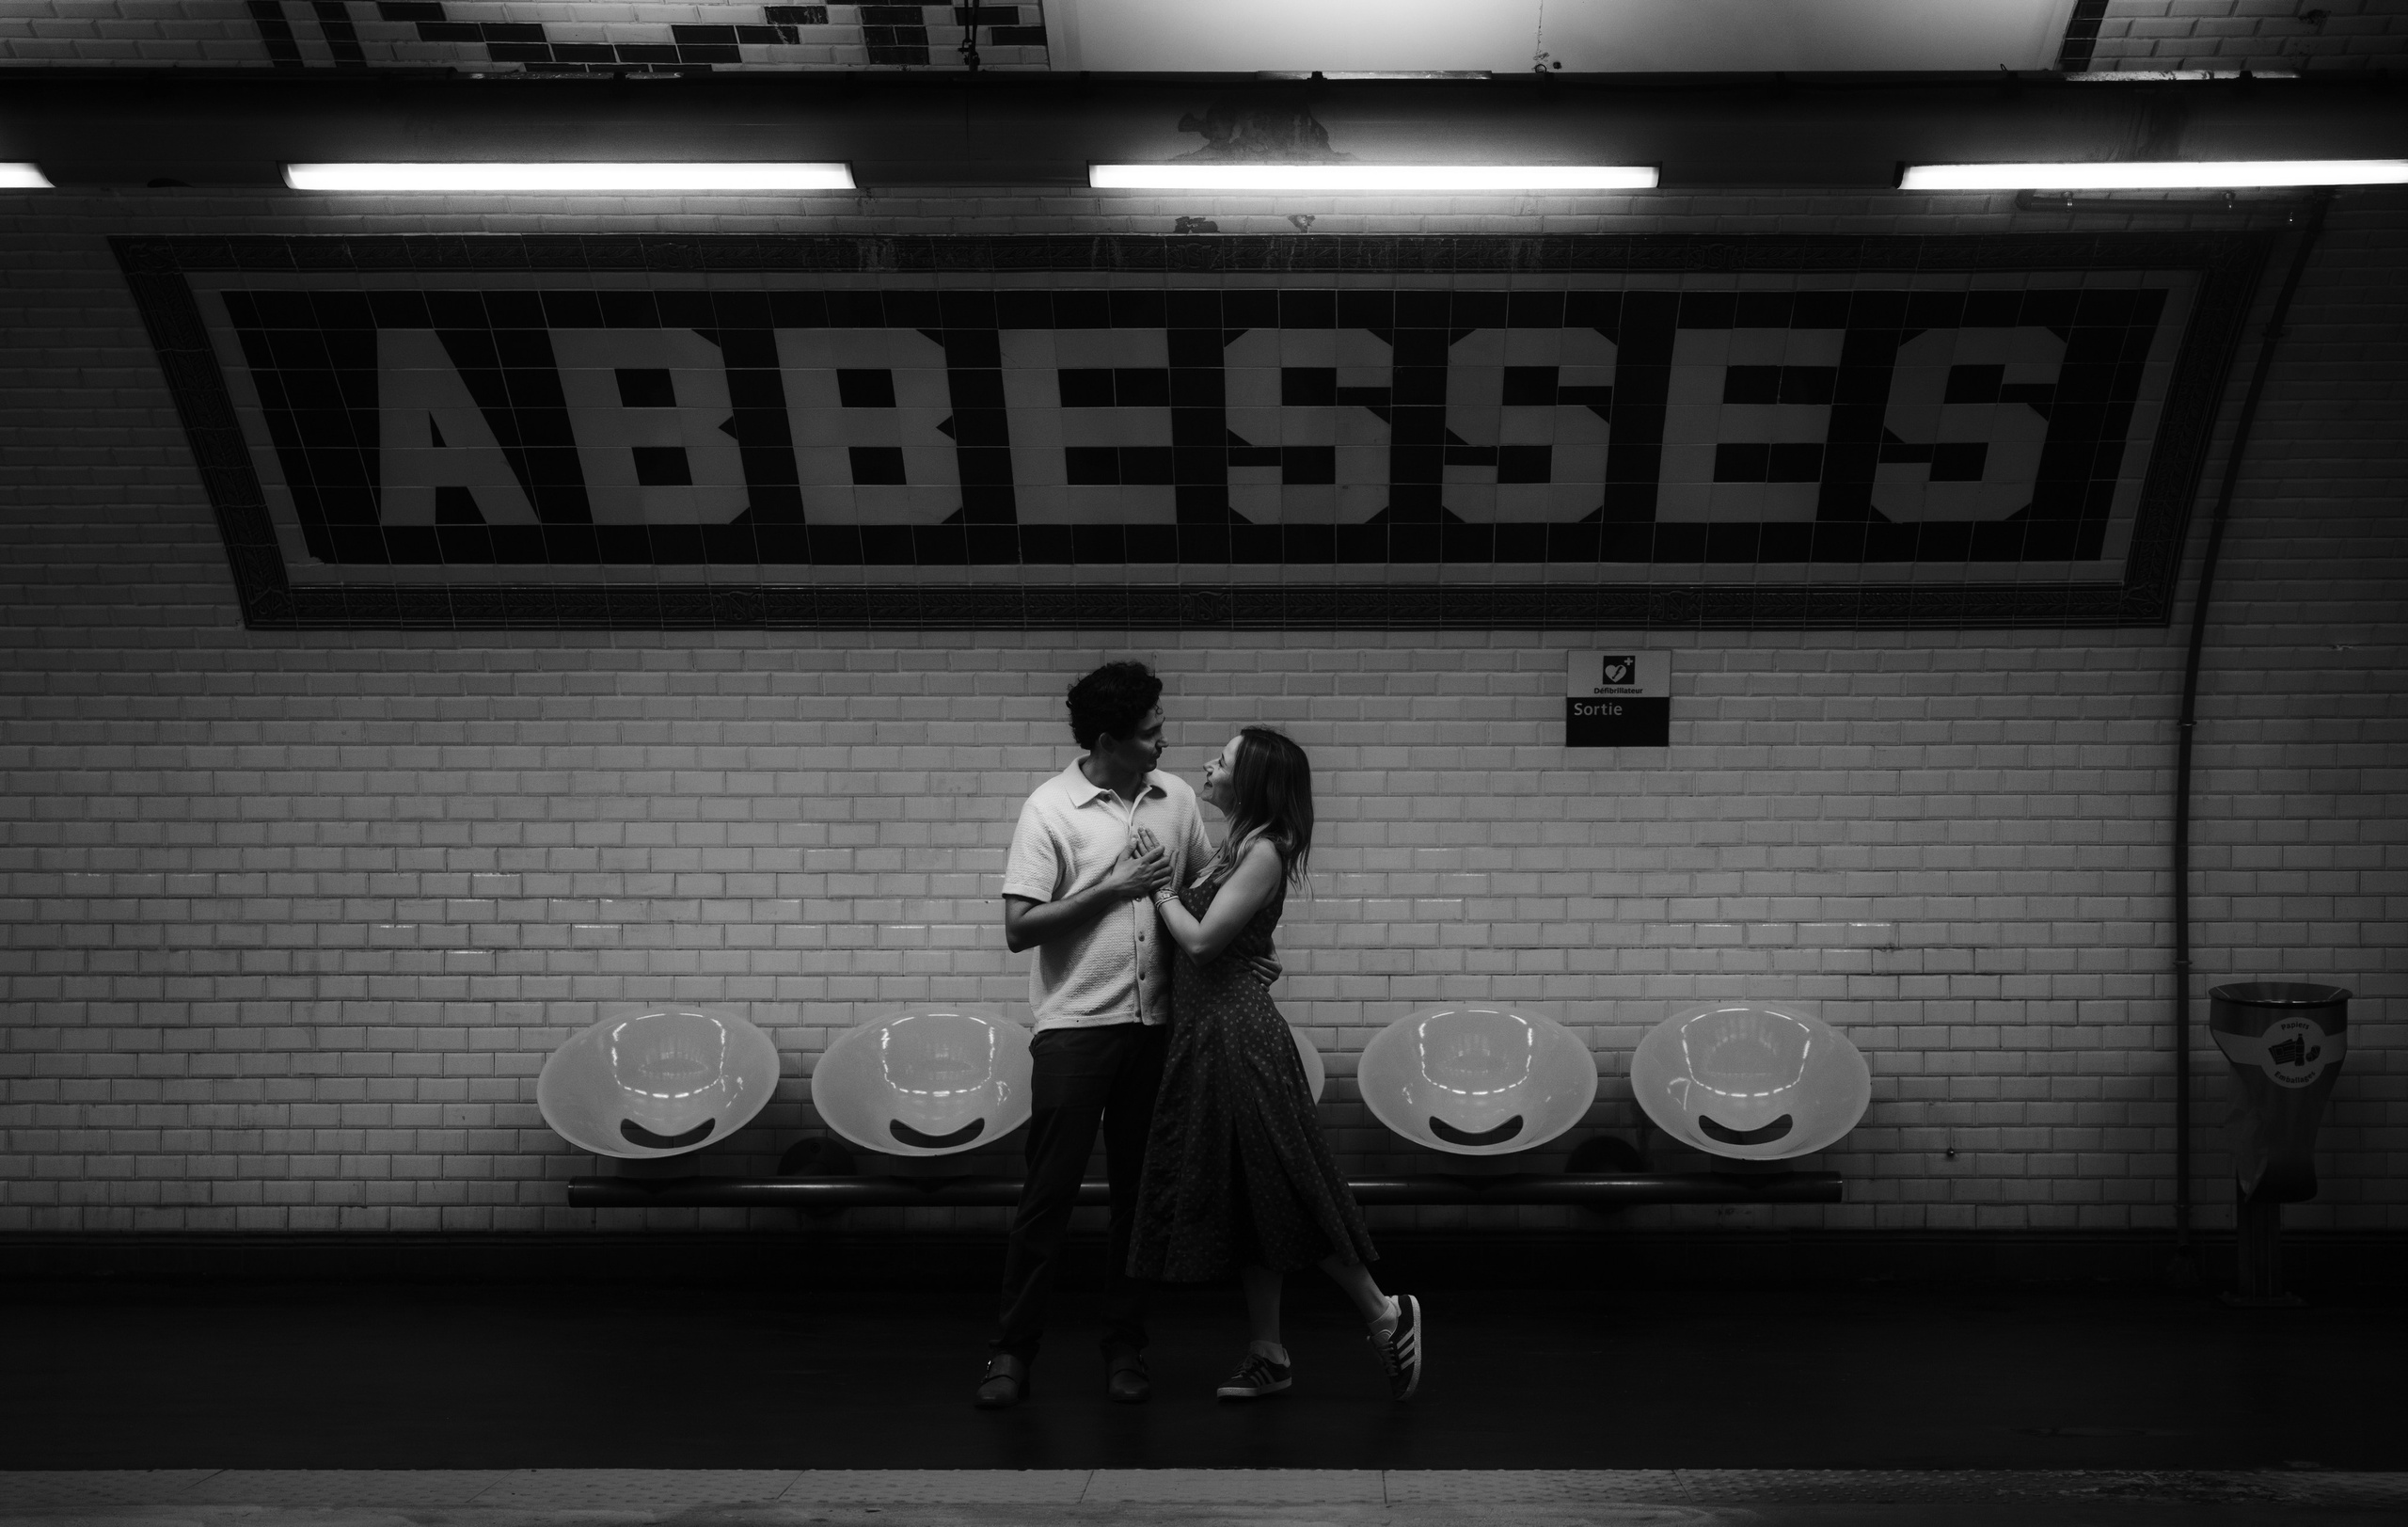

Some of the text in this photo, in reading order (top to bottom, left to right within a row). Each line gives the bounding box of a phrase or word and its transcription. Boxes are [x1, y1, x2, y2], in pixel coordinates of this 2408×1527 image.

[378, 326, 2066, 526] ABBESSES
[1574, 703, 1623, 716] Sortie
[2281, 1022, 2309, 1033] Papiers
[2274, 1071, 2316, 1083] Emballages
